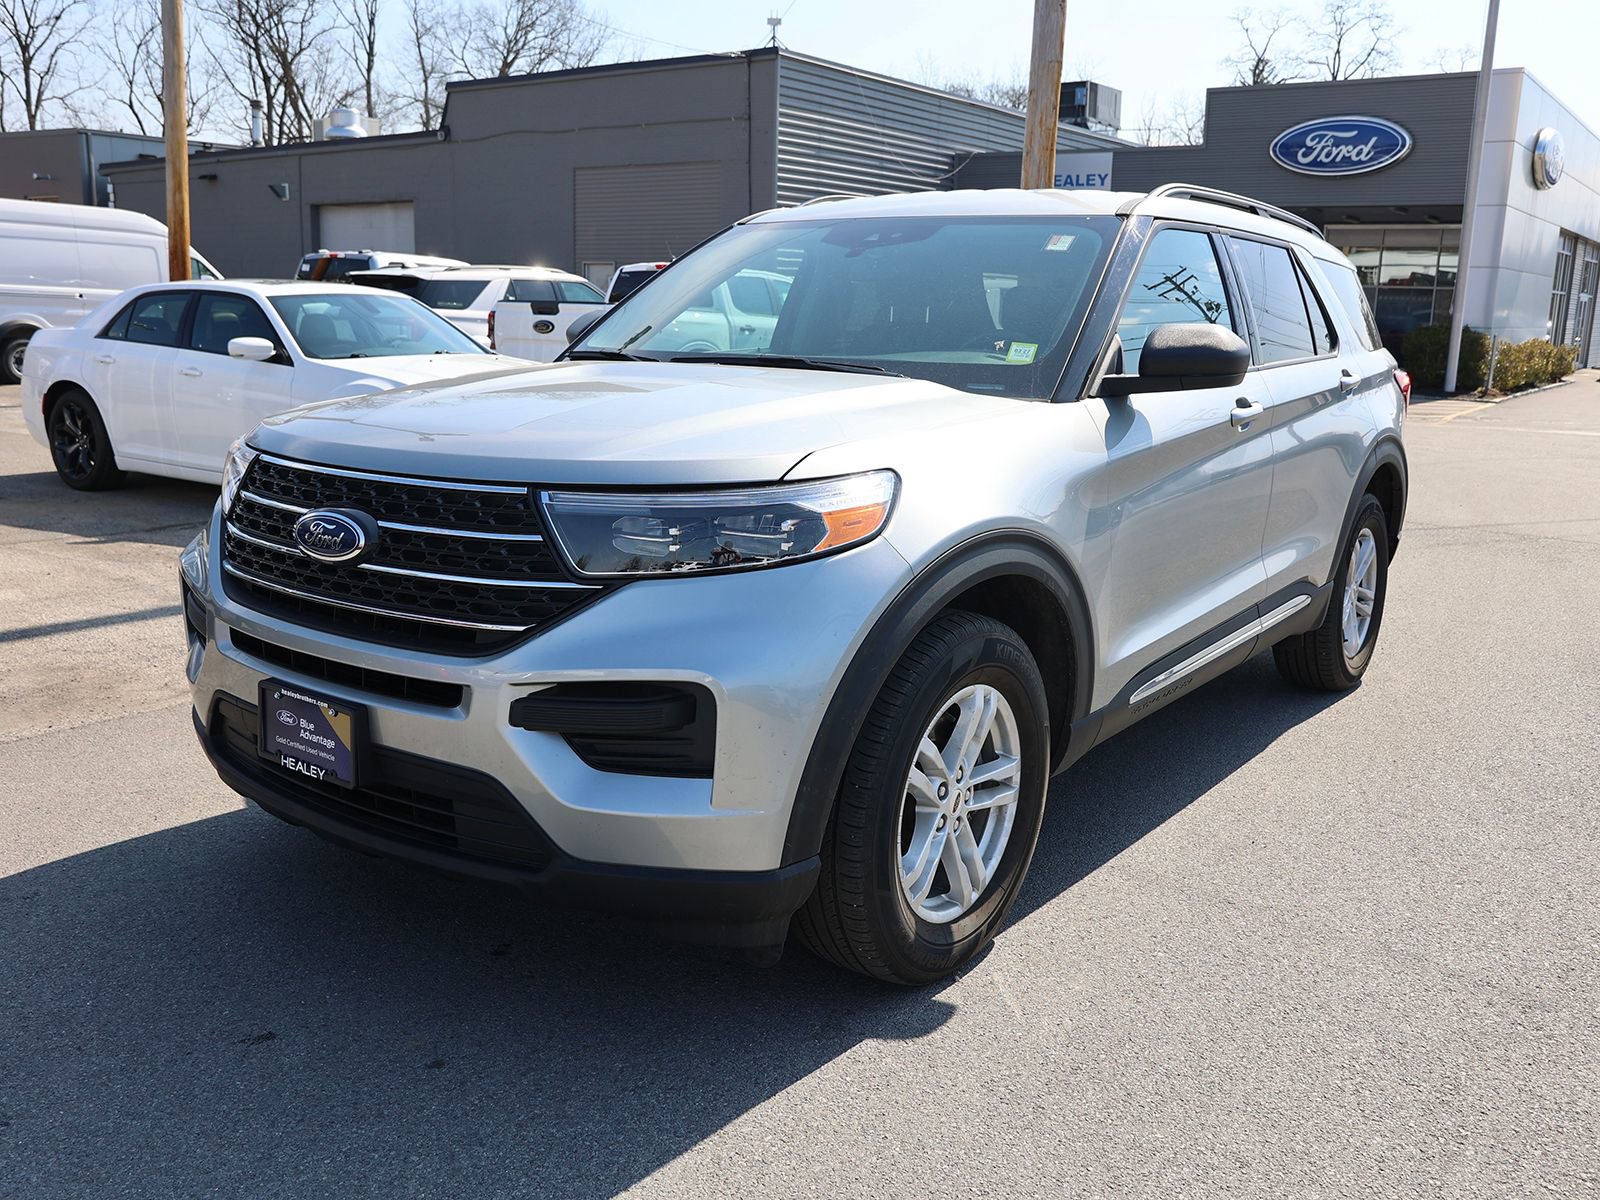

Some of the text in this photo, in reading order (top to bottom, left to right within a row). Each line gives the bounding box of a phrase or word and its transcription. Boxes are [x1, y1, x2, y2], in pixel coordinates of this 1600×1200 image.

[1297, 130, 1378, 164] Ford
[1054, 173, 1109, 187] EALEY
[305, 520, 345, 550] Ford
[281, 688, 328, 708] healeybrothers.com
[279, 711, 295, 723] Ford
[300, 718, 315, 731] Blue
[275, 735, 336, 762] Gold Certified Used Vehicle
[300, 729, 336, 749] Advantage
[281, 754, 326, 780] HEALEY
